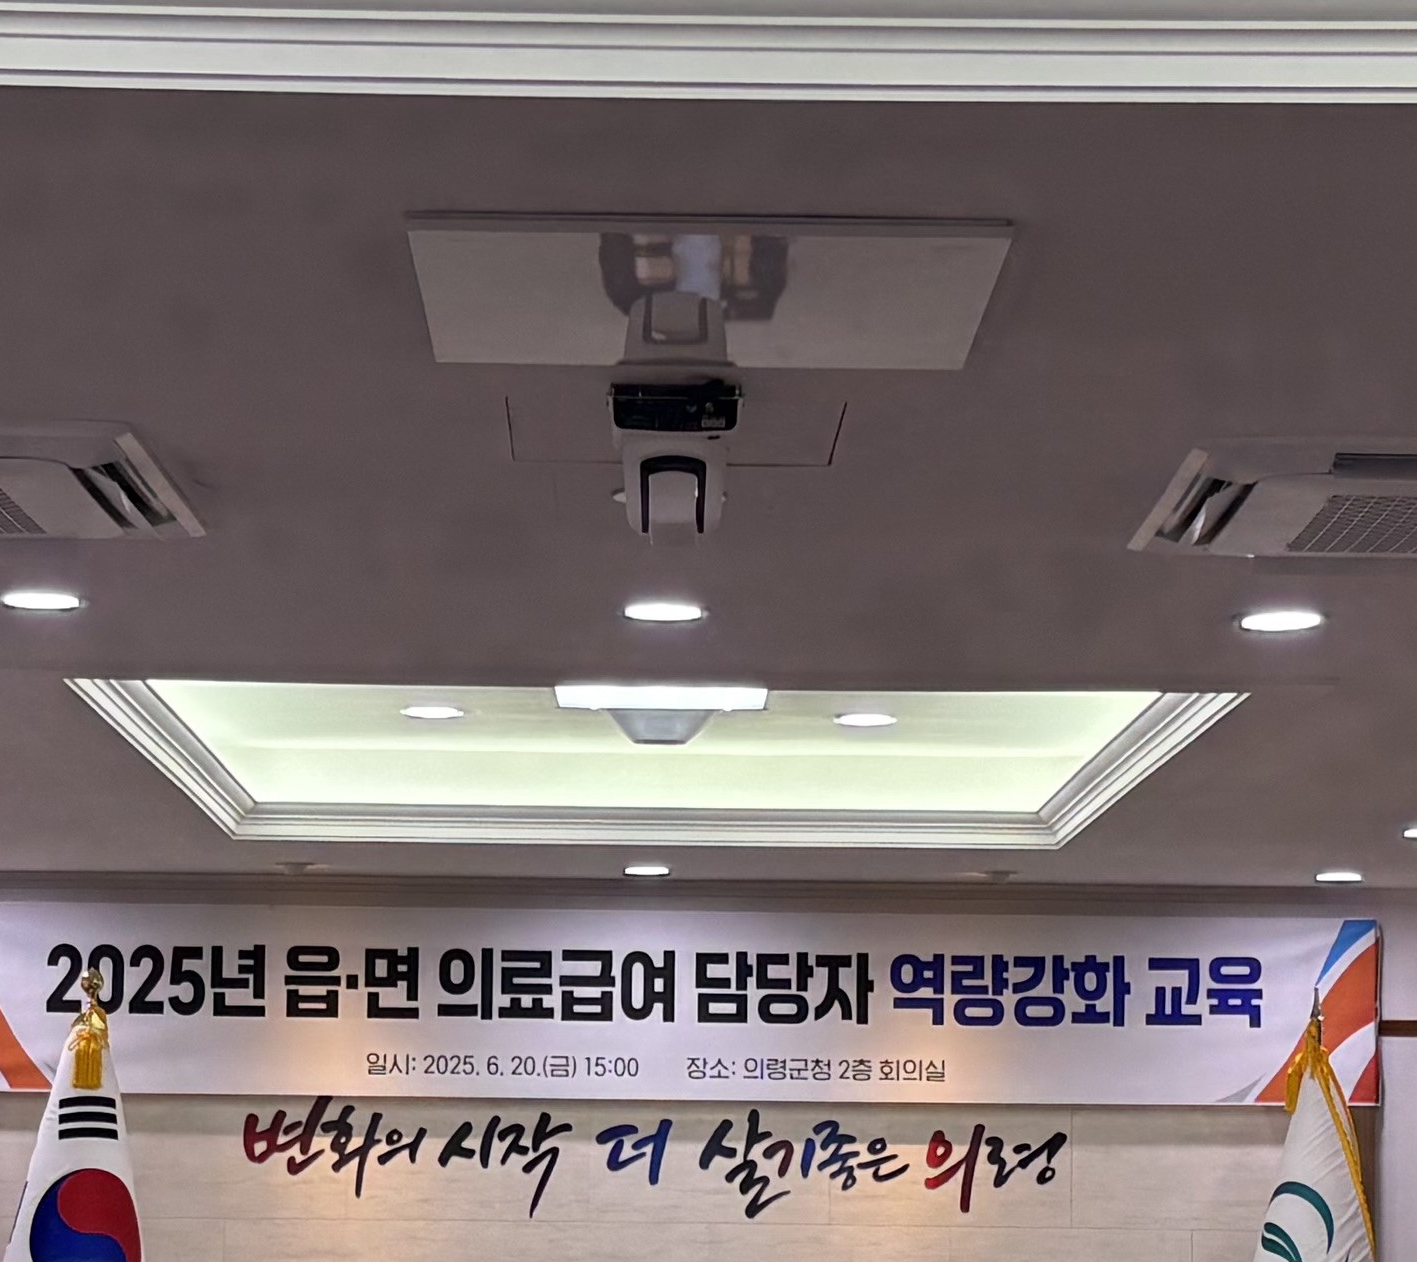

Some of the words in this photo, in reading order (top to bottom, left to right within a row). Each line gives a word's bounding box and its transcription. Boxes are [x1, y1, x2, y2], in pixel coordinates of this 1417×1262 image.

[46, 943, 267, 1017] 2025년
[284, 945, 420, 1020] 읍·면
[438, 947, 676, 1023] 의료급여
[695, 951, 875, 1025] 담당자
[889, 952, 1131, 1027] 역량강화
[1145, 956, 1263, 1028] 교육
[366, 1052, 416, 1076] 일시:
[423, 1054, 480, 1077] 2025.
[486, 1055, 504, 1077] 6.
[511, 1055, 578, 1079] 20.(금)
[585, 1056, 640, 1077] 15:00
[686, 1057, 736, 1080] 장소:
[743, 1057, 832, 1081] 의령군청
[838, 1058, 873, 1082] 2층
[879, 1059, 946, 1083] 회의실
[243, 1096, 428, 1198] 변화의
[437, 1111, 573, 1218] 시작
[595, 1118, 673, 1186] 더
[698, 1108, 910, 1219] 살기좋은
[924, 1122, 1069, 1214] 의령
